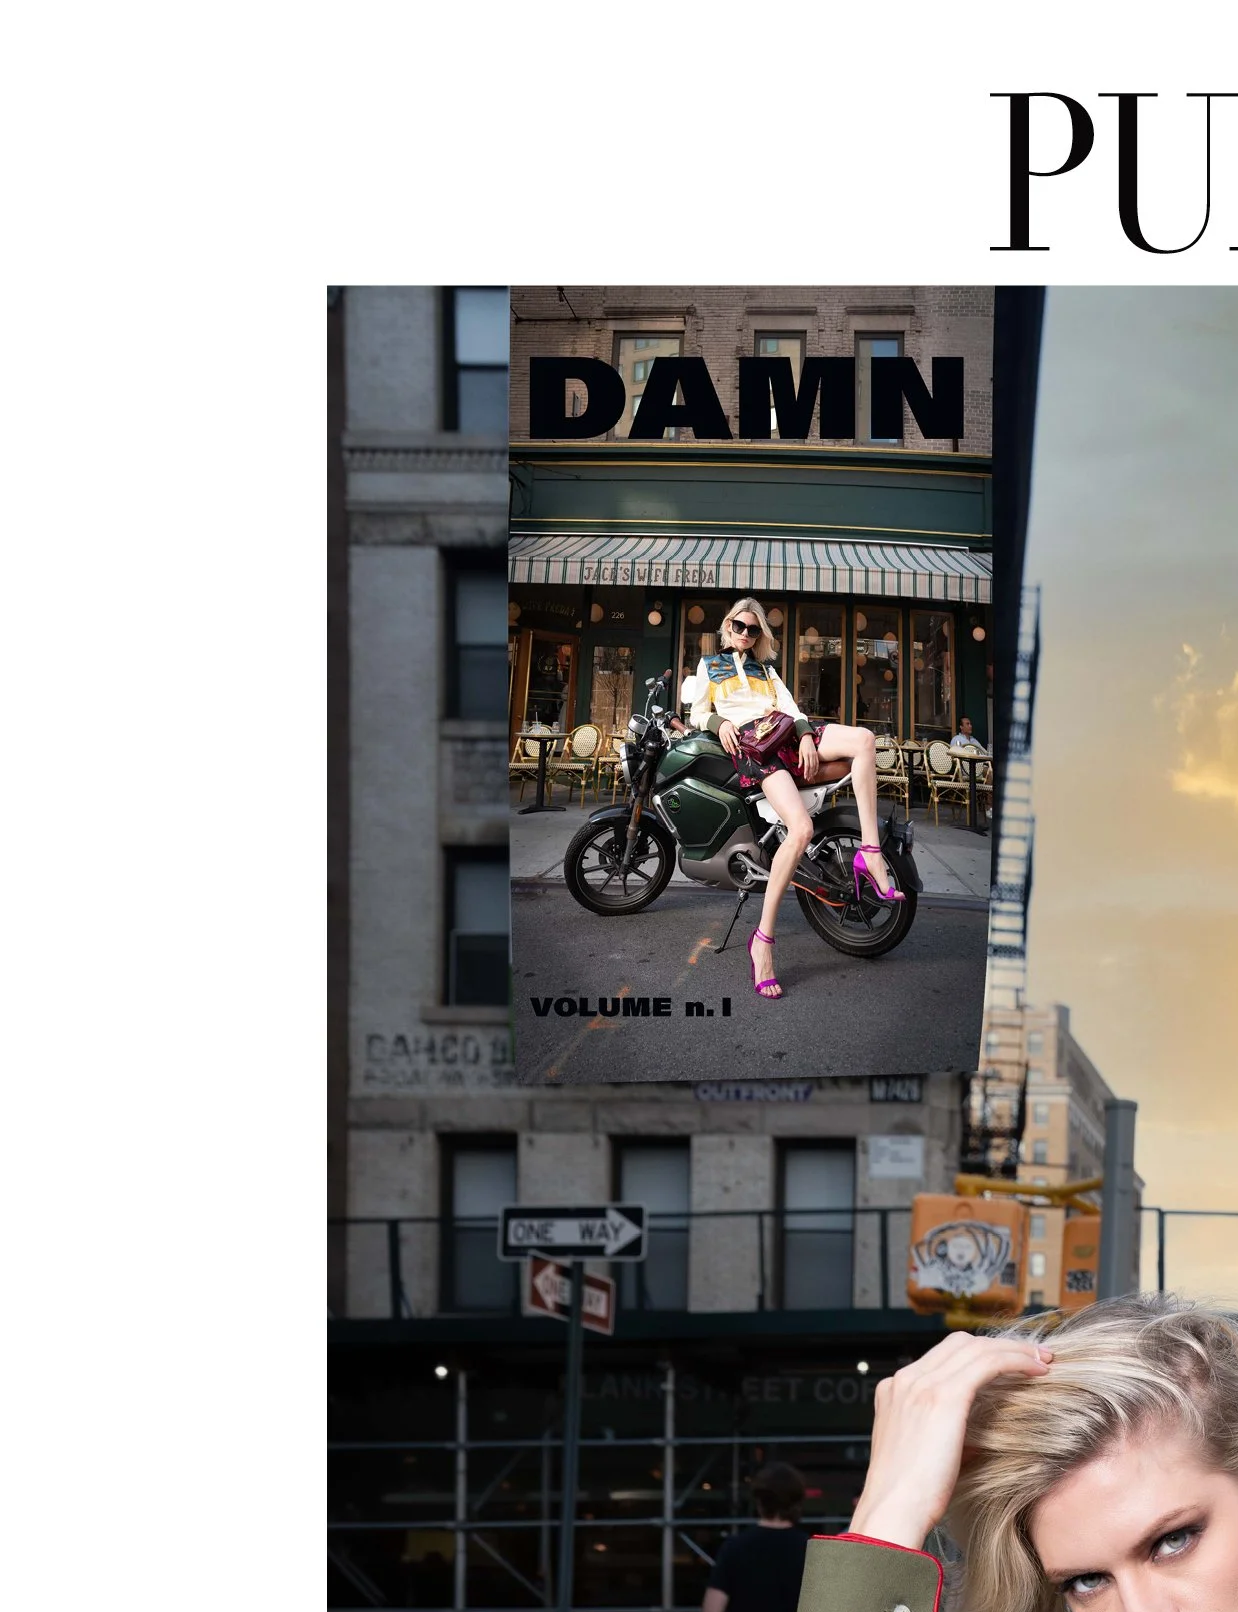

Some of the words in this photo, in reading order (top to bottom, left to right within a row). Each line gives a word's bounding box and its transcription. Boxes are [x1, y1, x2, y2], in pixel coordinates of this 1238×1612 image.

[529, 356, 964, 440] DAMN
[674, 568, 715, 584] FREDA
[611, 611, 625, 620] 226
[530, 997, 672, 1017] VOLUME
[512, 1221, 555, 1244] ONE
[578, 1221, 625, 1243] WAY
